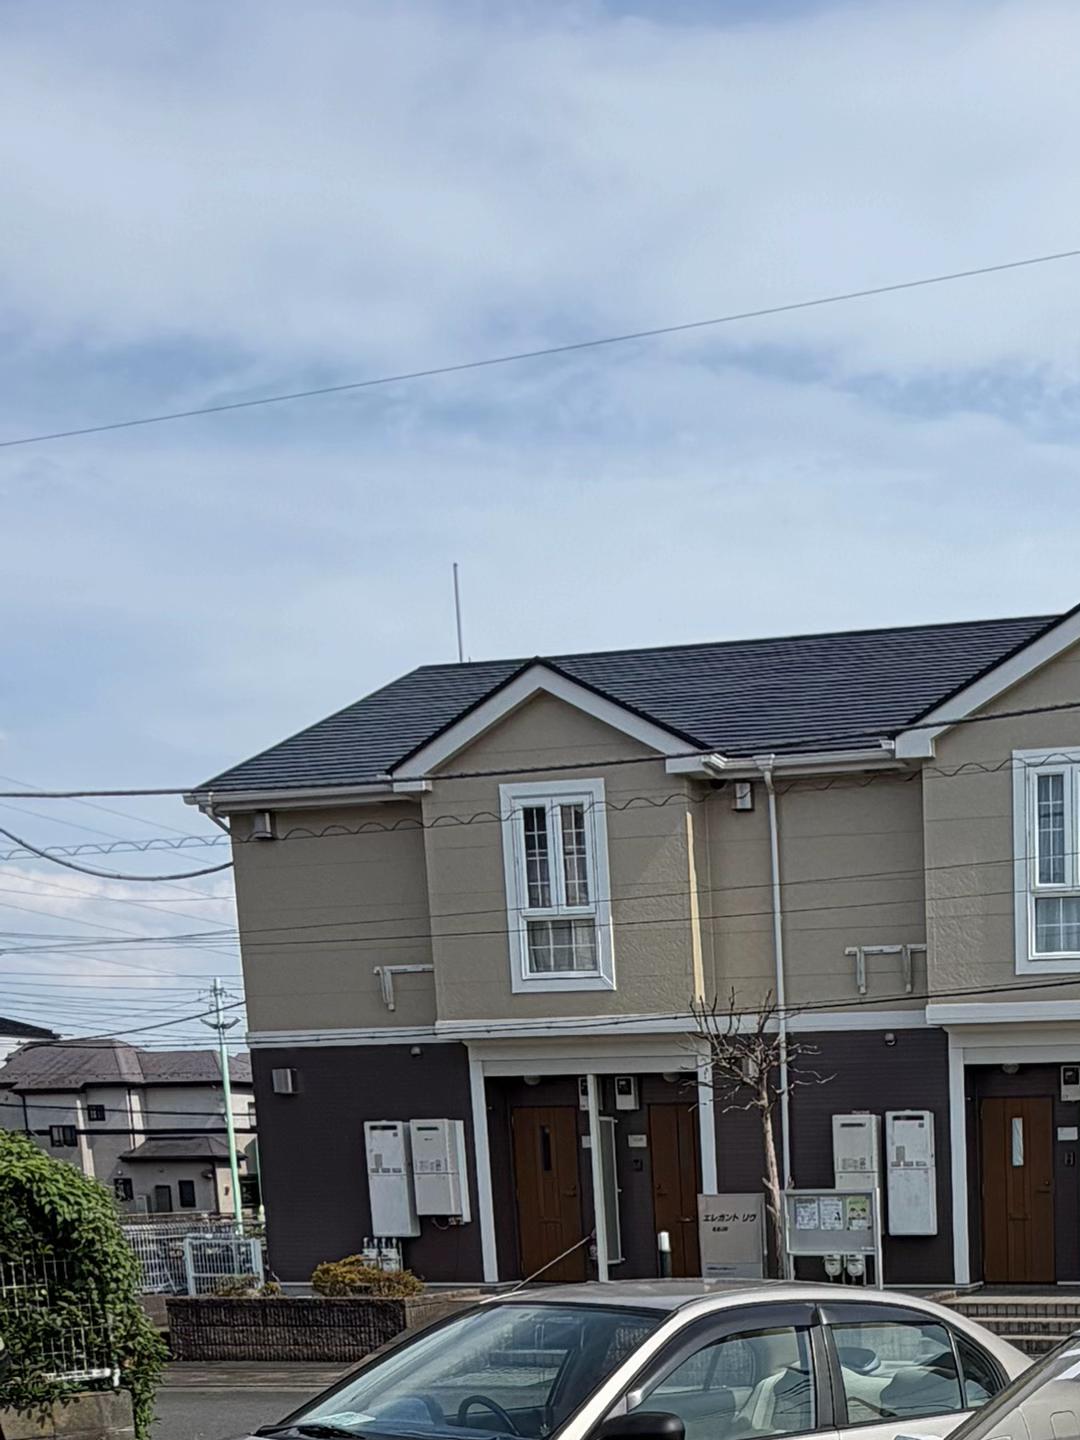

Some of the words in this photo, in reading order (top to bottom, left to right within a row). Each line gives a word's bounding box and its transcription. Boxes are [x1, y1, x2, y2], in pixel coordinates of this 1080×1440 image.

[703, 1213, 740, 1222] エレガント
